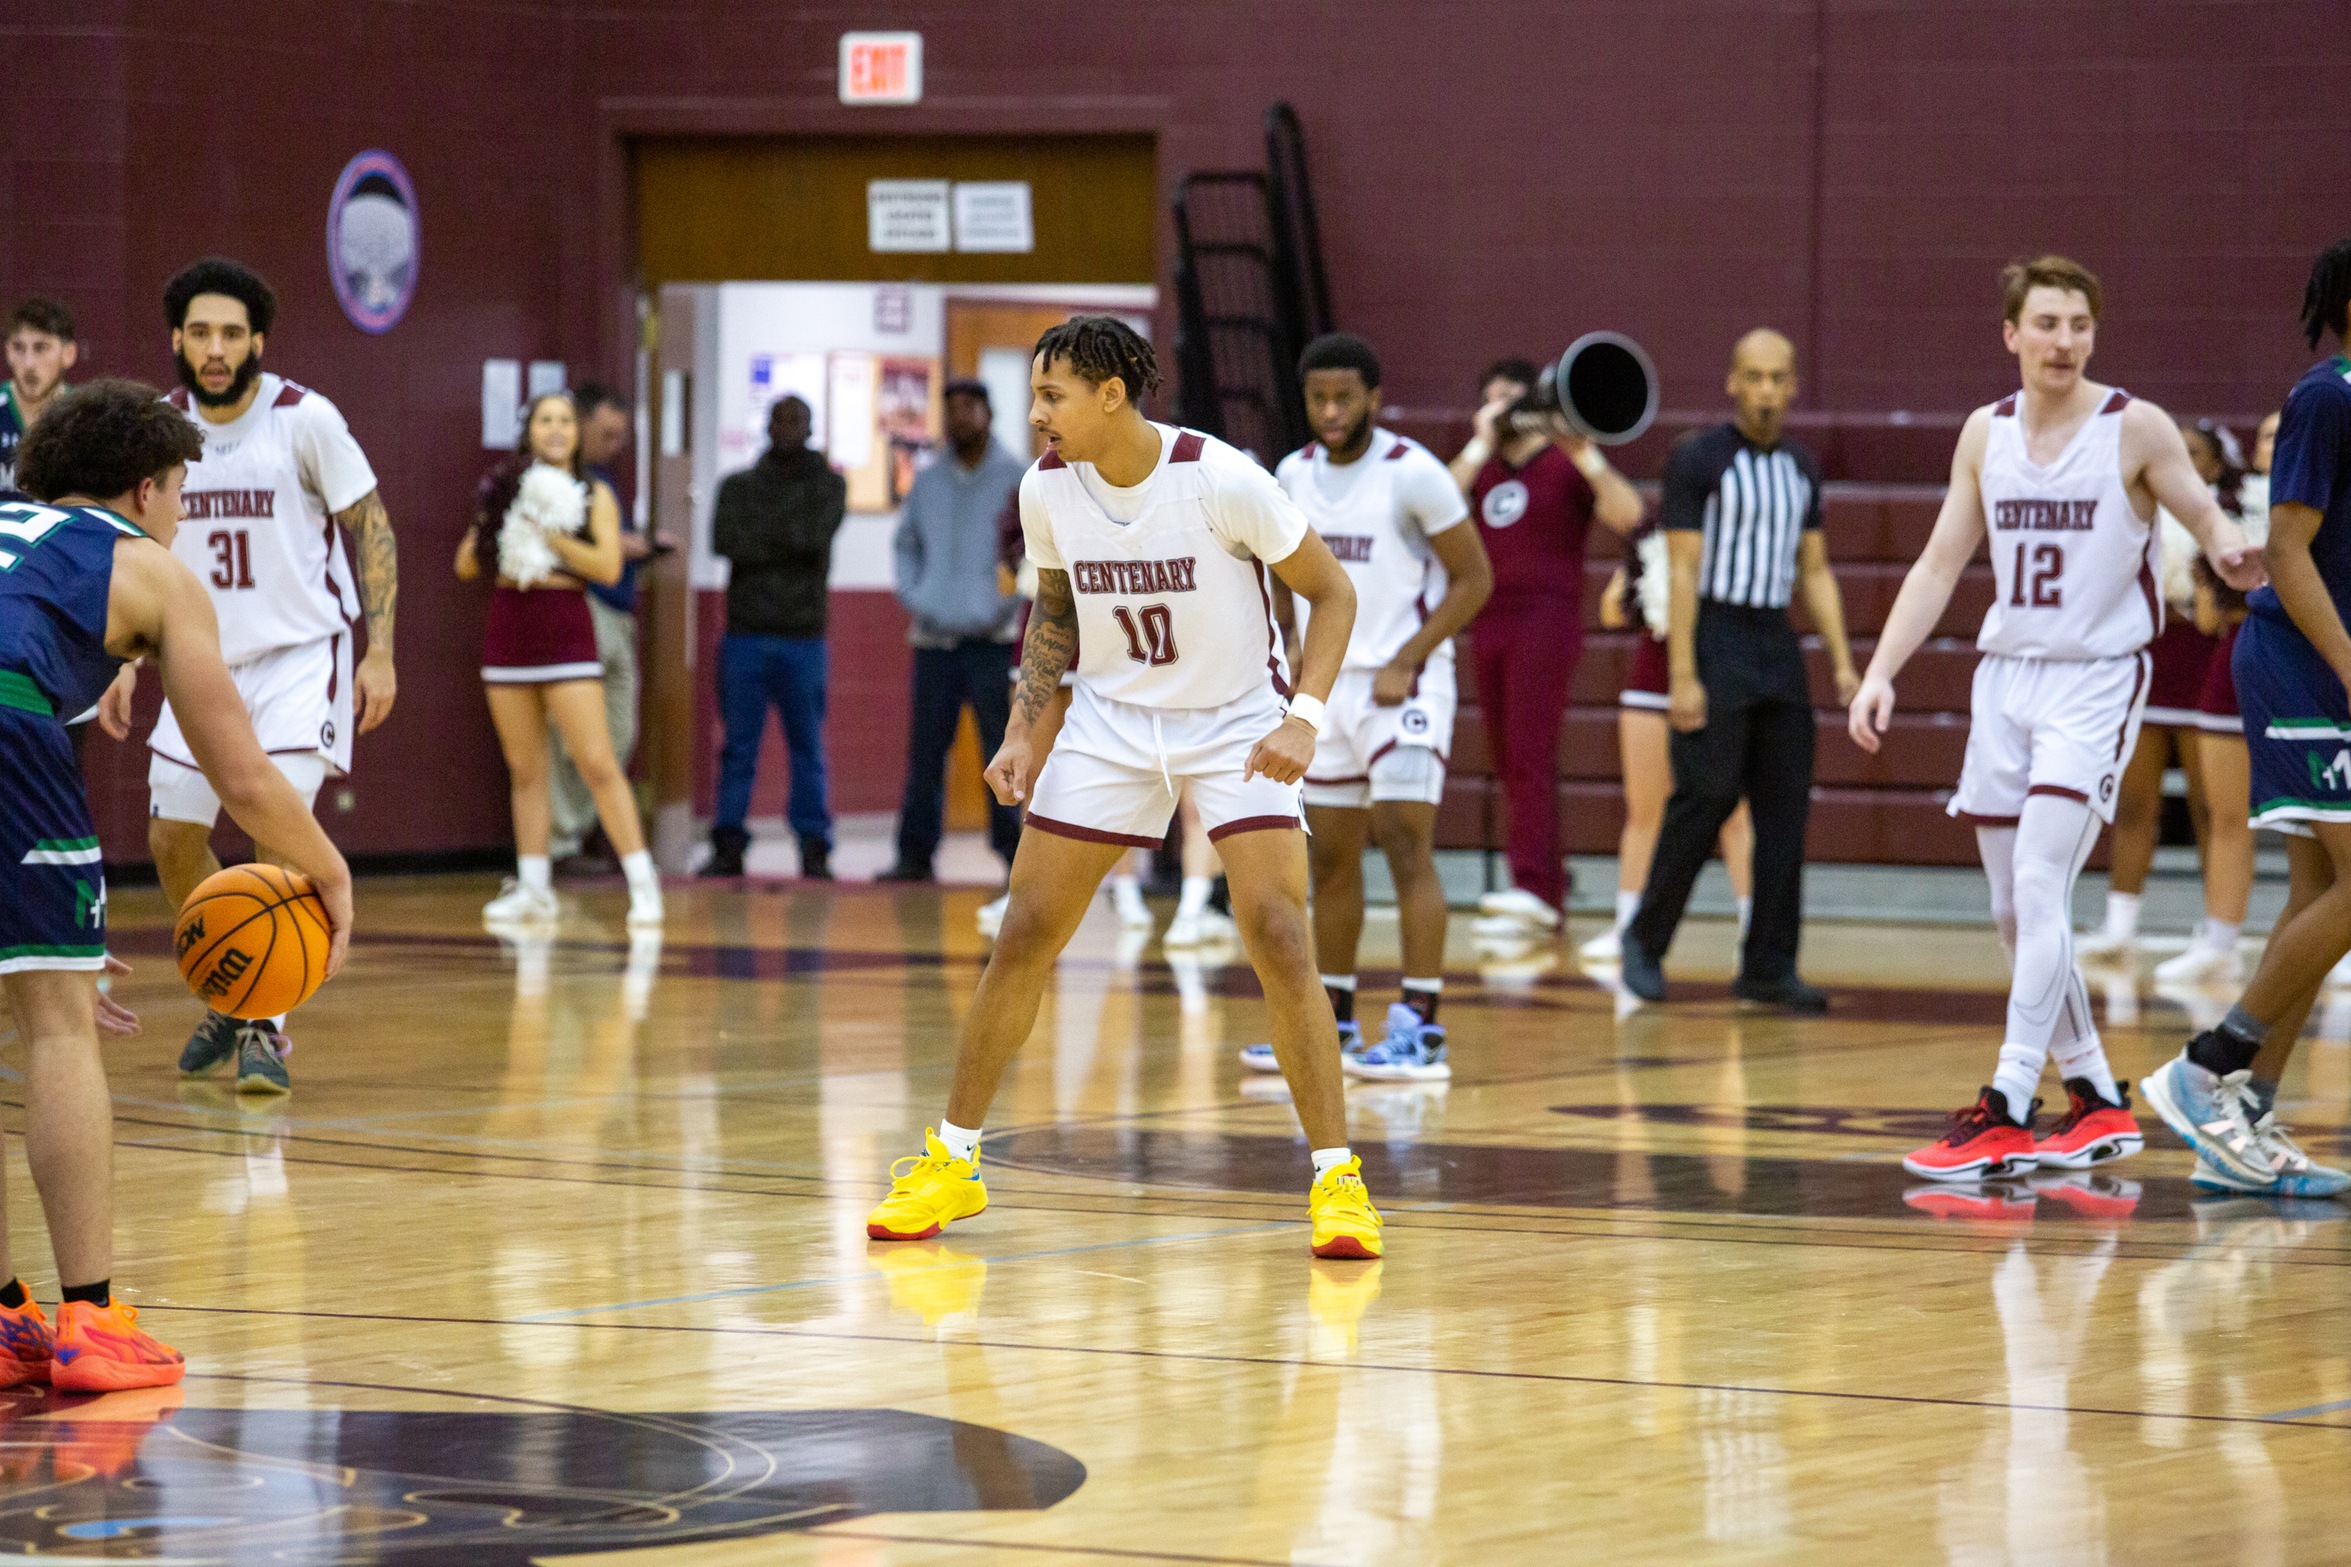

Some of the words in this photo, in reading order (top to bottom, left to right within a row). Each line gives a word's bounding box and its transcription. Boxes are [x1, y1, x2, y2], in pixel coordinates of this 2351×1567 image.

[1995, 499, 2097, 530] CENTENARY
[208, 530, 256, 591] 31
[1073, 557, 1197, 595] CENTENARY
[2010, 543, 2065, 608] 12
[1112, 602, 1179, 668] 10
